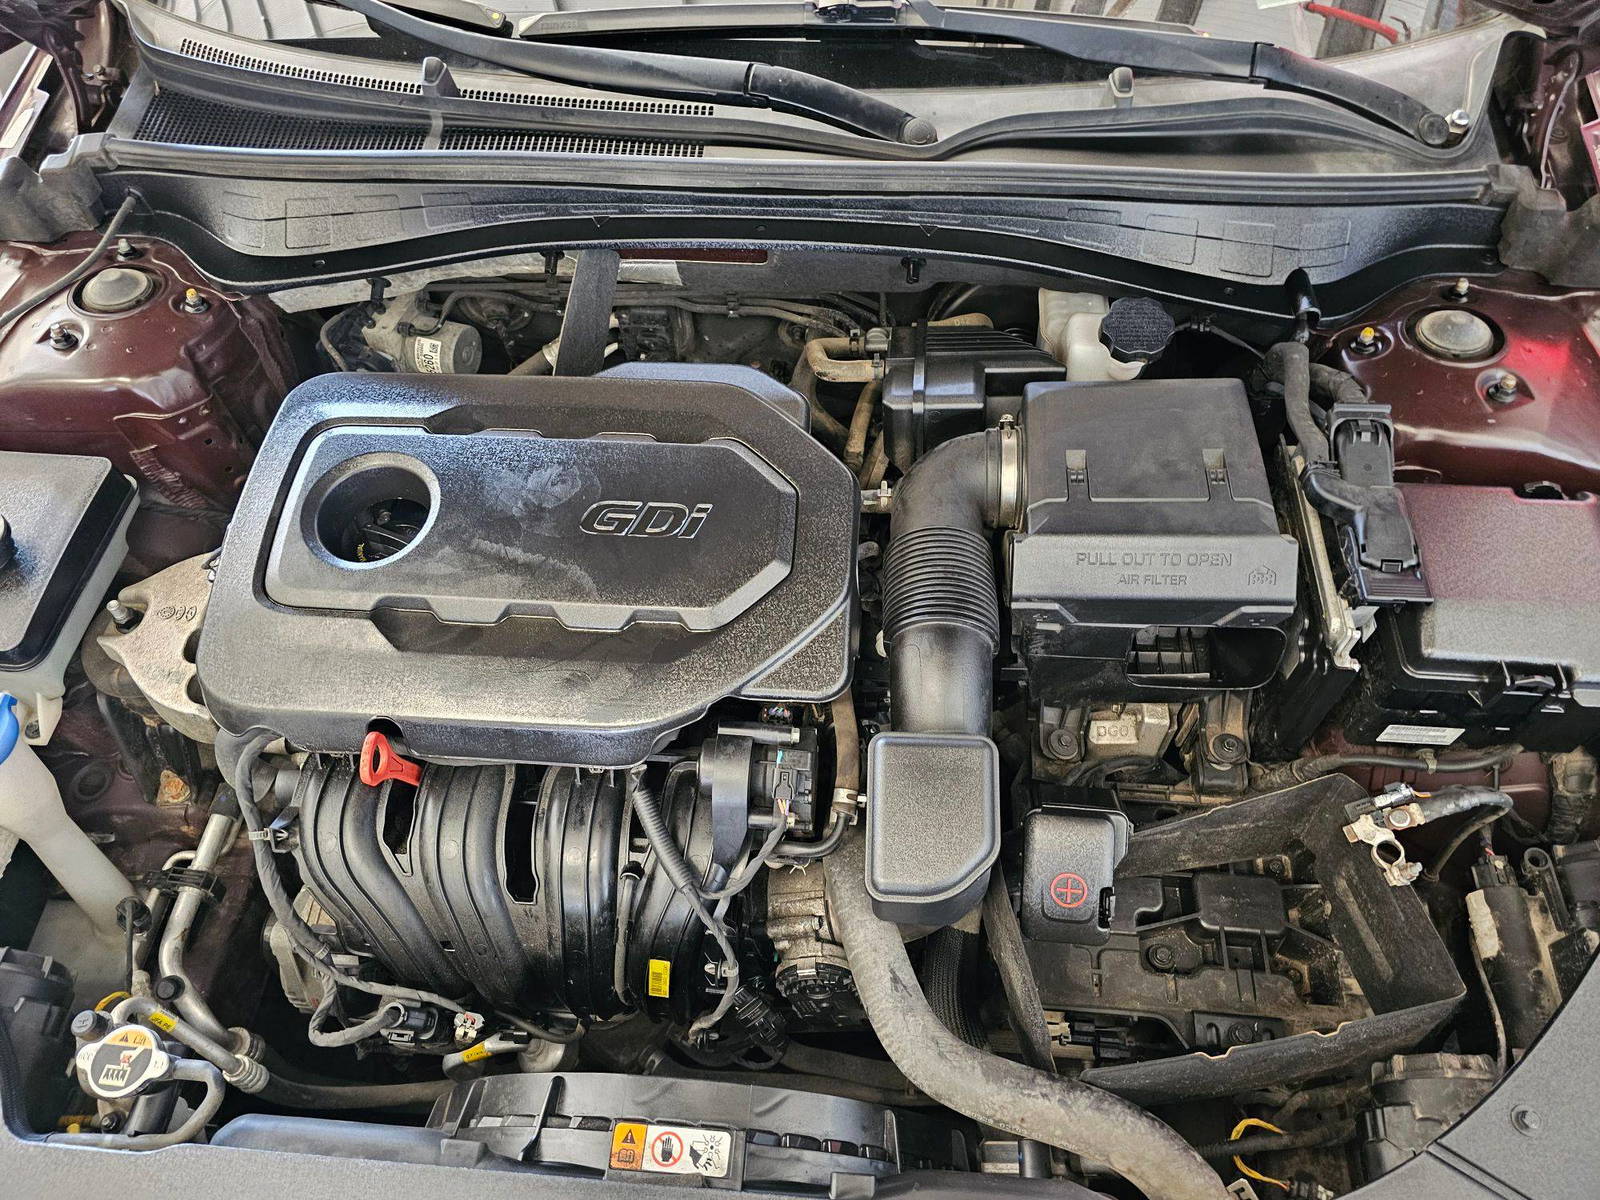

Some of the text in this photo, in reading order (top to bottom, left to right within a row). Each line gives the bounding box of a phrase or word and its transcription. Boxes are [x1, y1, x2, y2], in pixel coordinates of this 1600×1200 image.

[579, 500, 713, 538] GDi
[1075, 552, 1233, 567] PULL OUT TO OPEN
[1116, 574, 1187, 586] AIR FILTER
